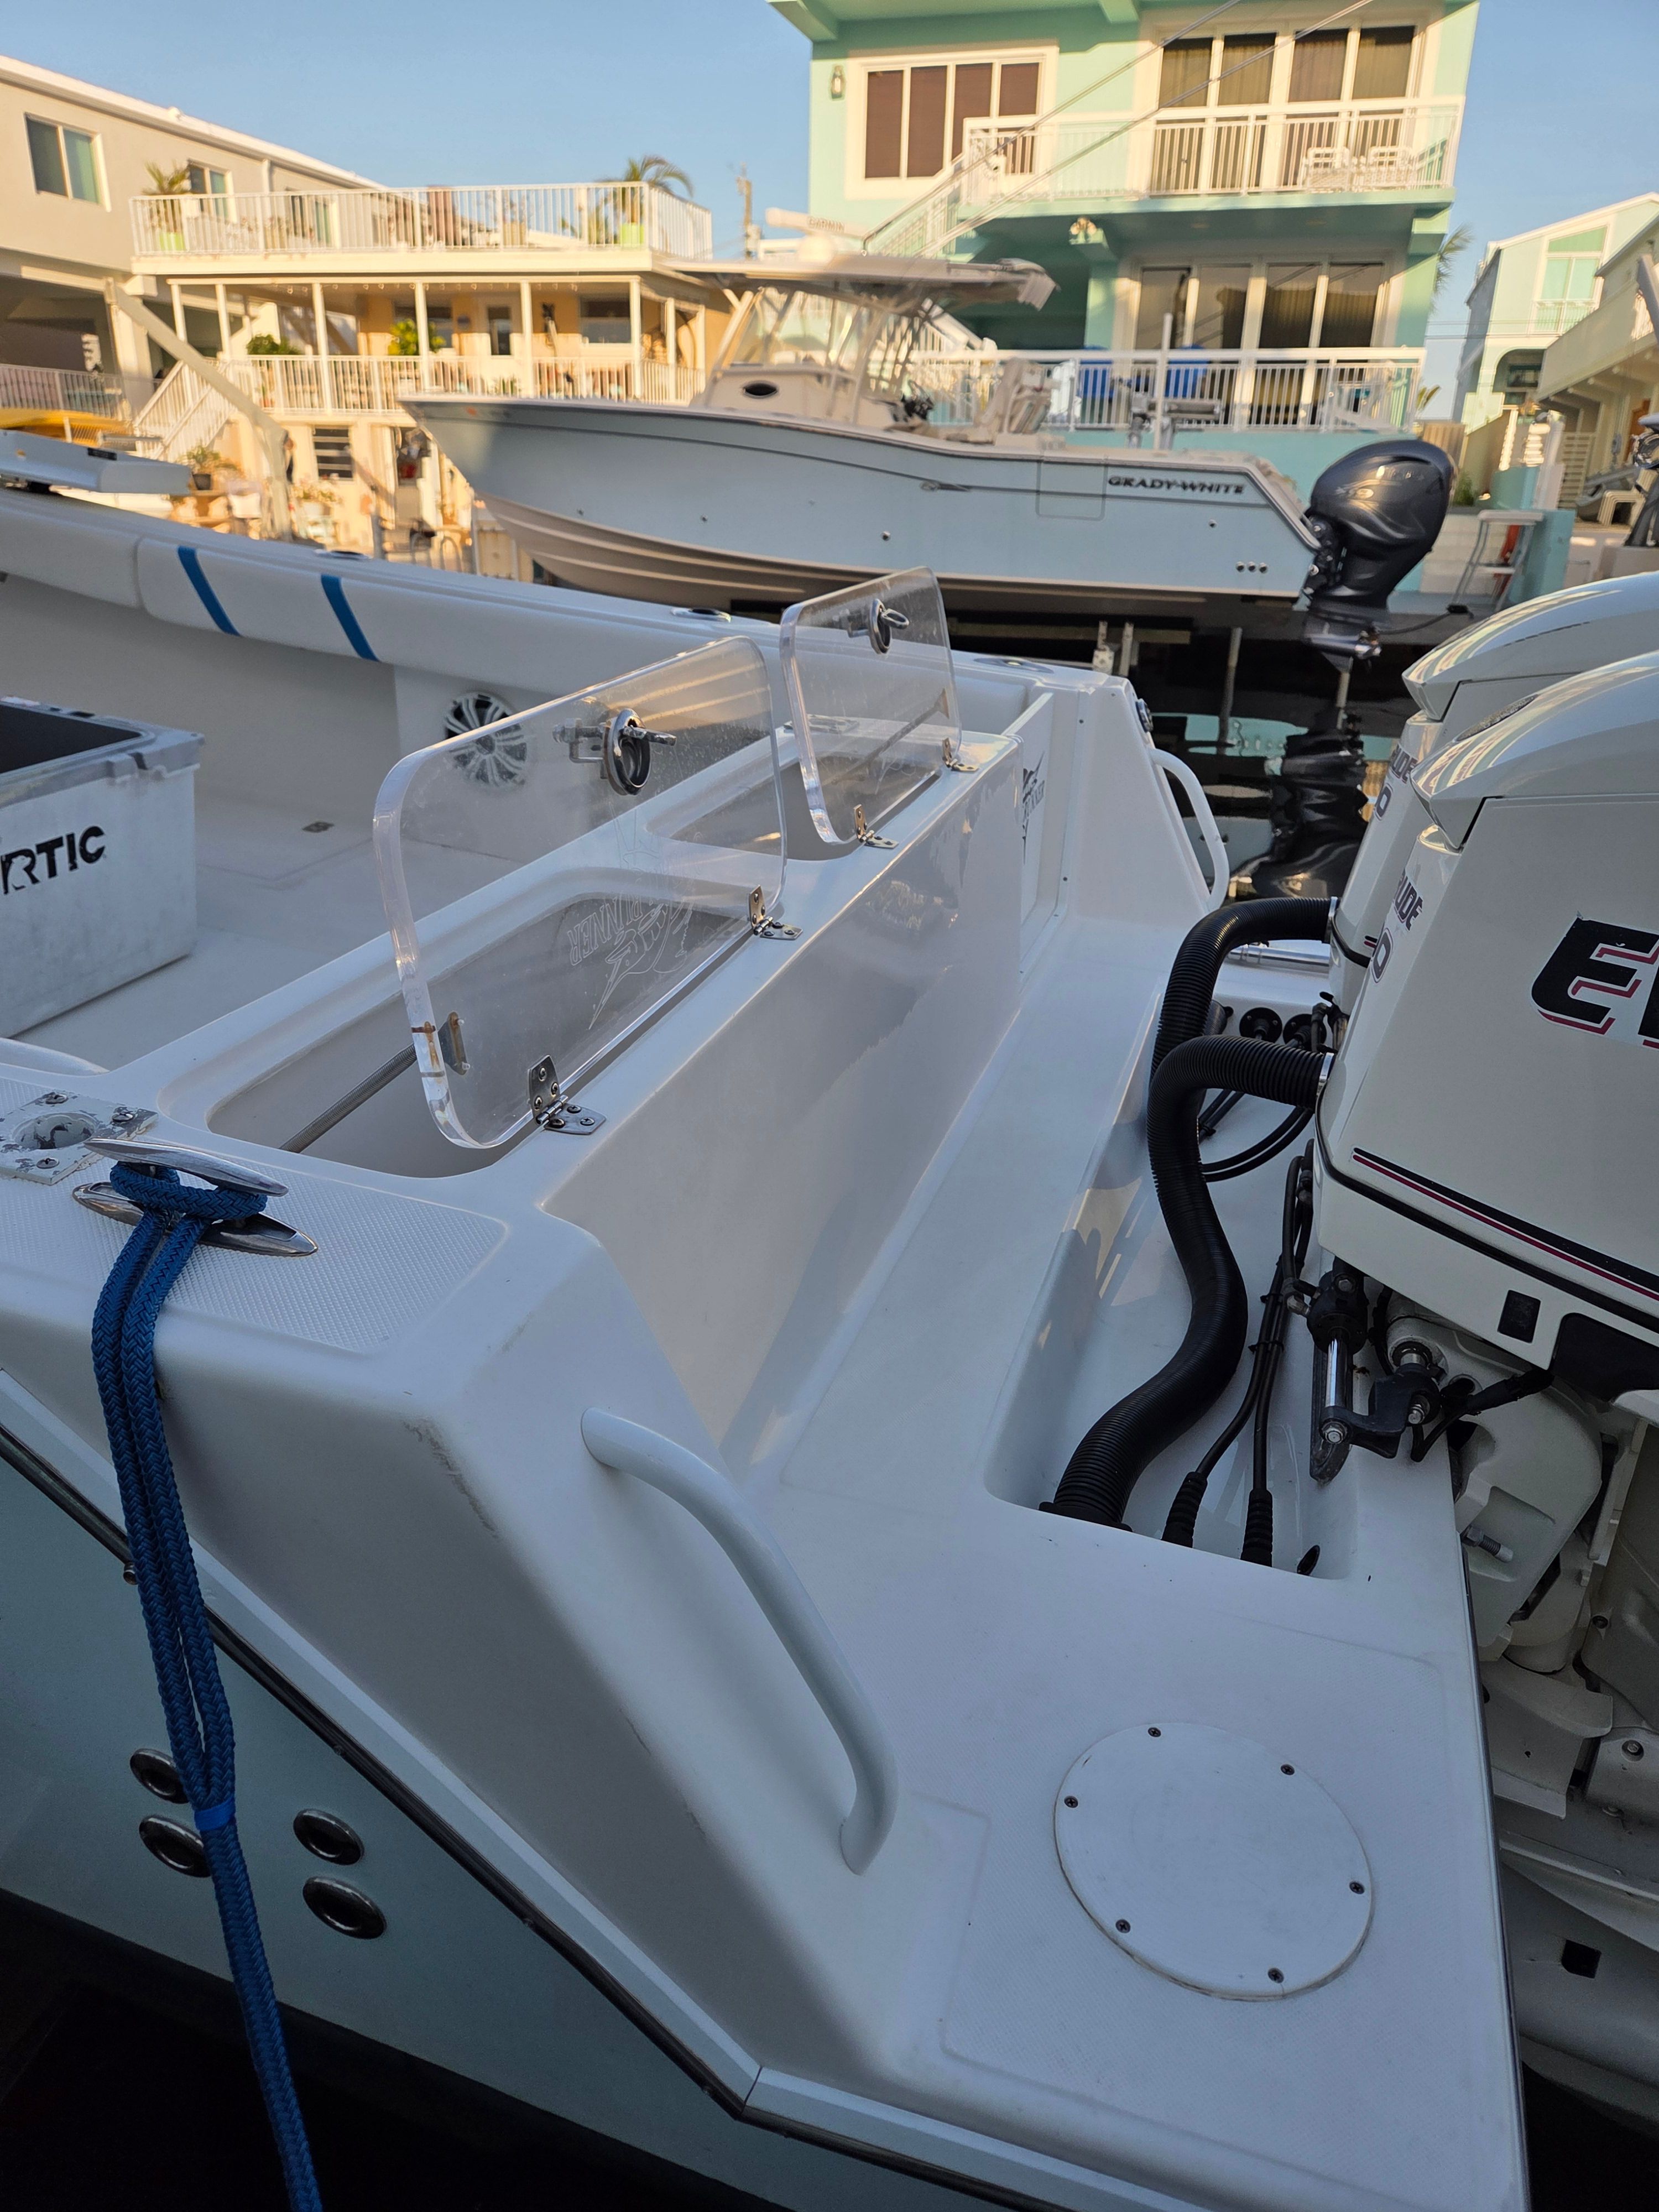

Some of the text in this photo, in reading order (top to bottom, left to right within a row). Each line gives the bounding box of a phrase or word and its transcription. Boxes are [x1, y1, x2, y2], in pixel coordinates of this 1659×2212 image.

[1108, 476, 1243, 494] GRADY-WHITE
[1, 826, 105, 895] RTIC
[1393, 868, 1423, 931] UDE
